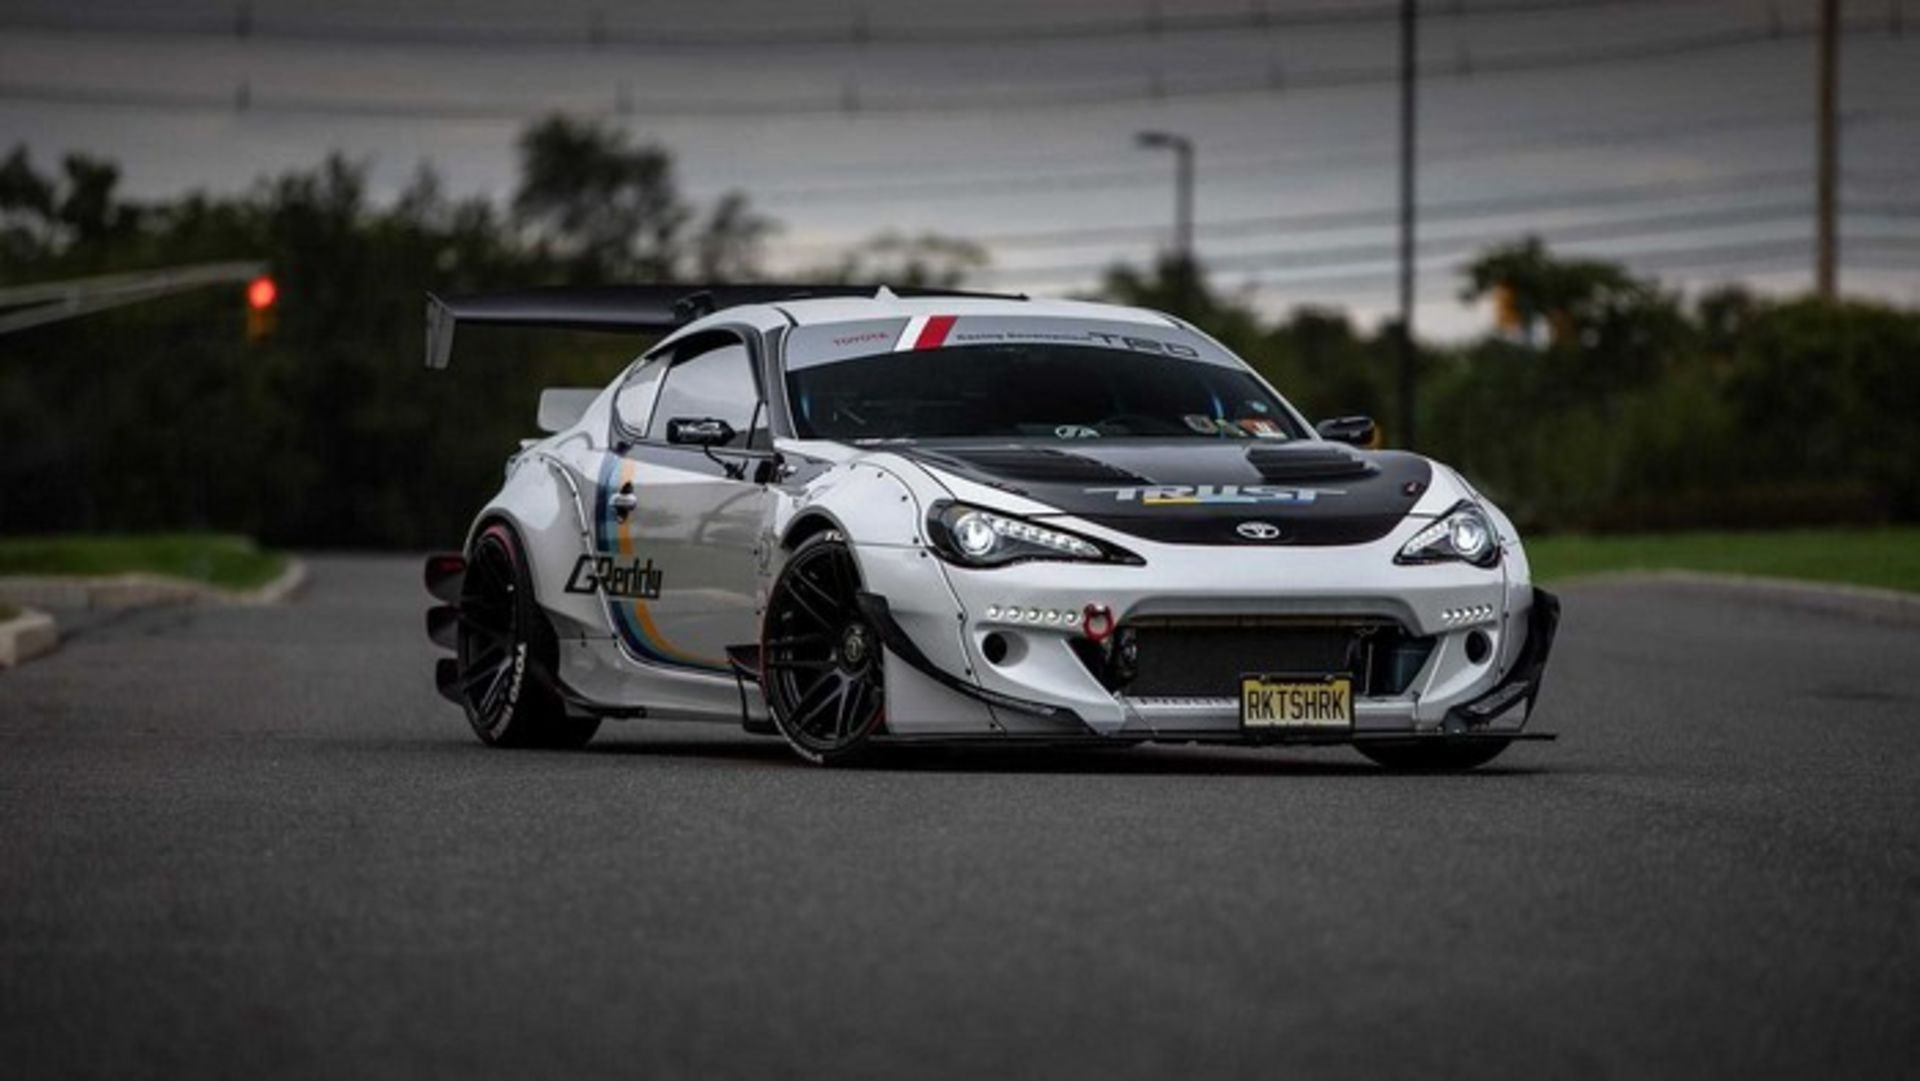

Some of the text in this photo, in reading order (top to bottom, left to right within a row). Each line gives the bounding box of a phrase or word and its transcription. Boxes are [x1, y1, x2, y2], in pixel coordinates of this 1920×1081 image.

[832, 332, 889, 346] TOYOTA
[1084, 485, 1346, 505] TRUST
[509, 642, 527, 704] TOYO
[1248, 690, 1345, 719] RKTSHRK
